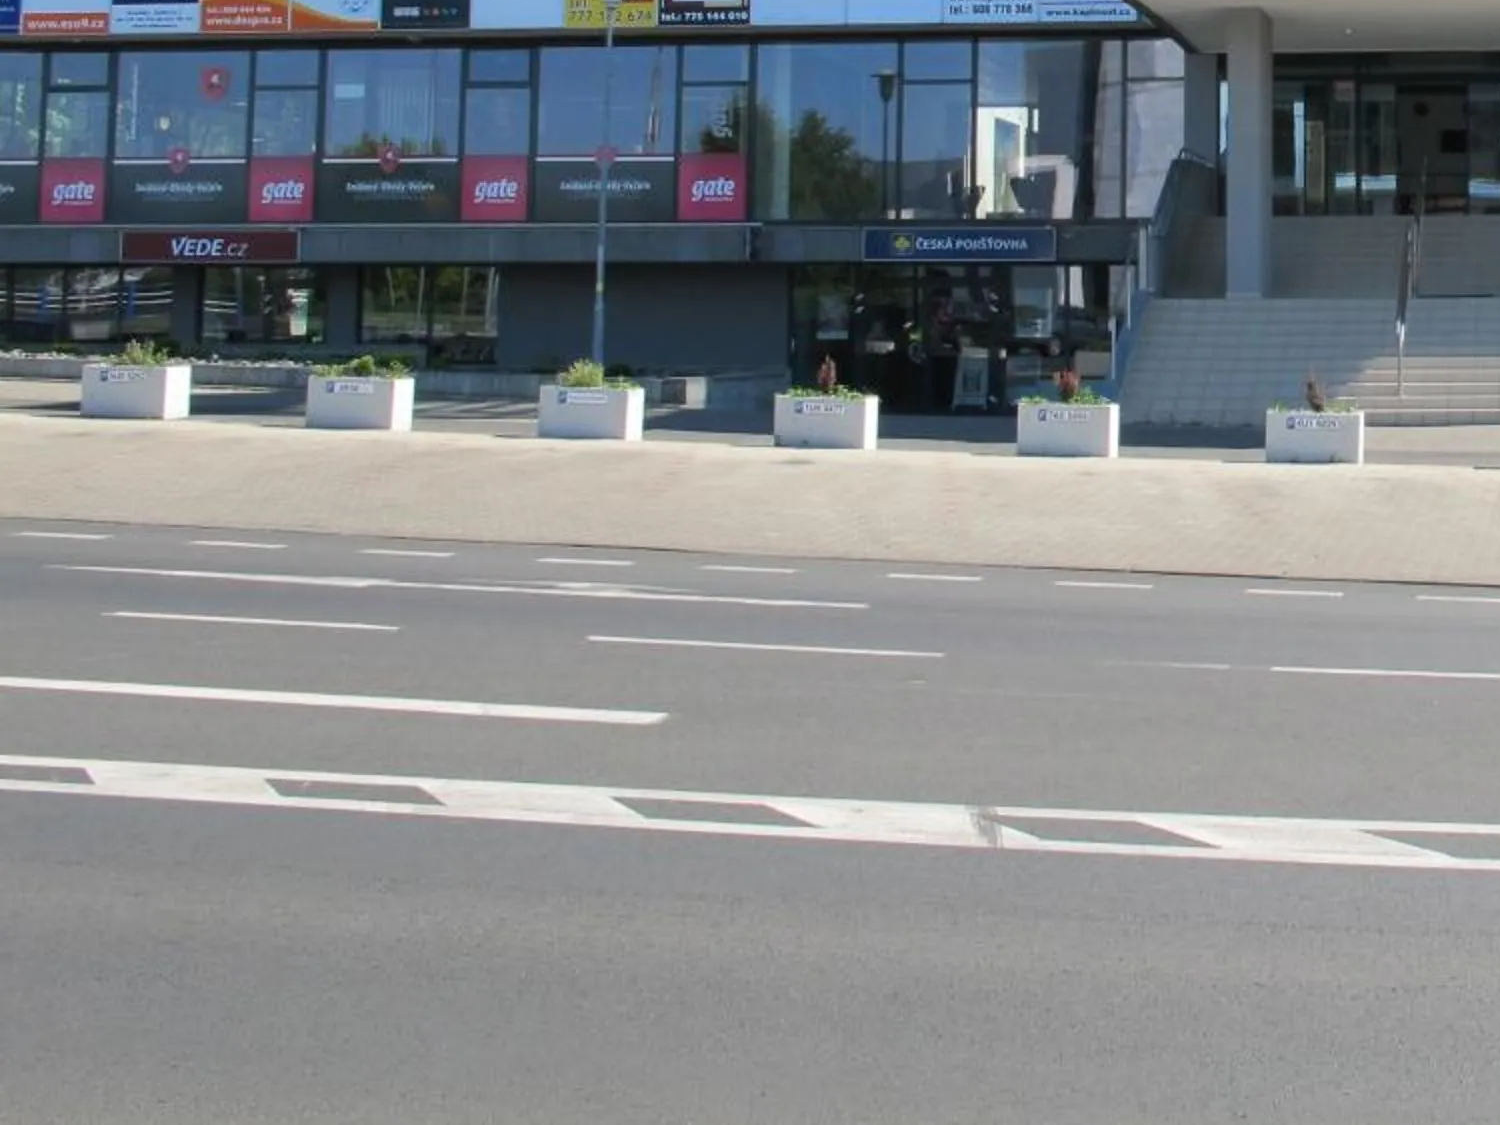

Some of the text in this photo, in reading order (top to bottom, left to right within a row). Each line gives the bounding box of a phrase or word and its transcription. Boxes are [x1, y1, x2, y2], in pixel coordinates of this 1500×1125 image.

[52, 181, 95, 205] gate
[261, 179, 305, 204] gate
[473, 179, 518, 204] gate
[691, 176, 735, 201] gate
